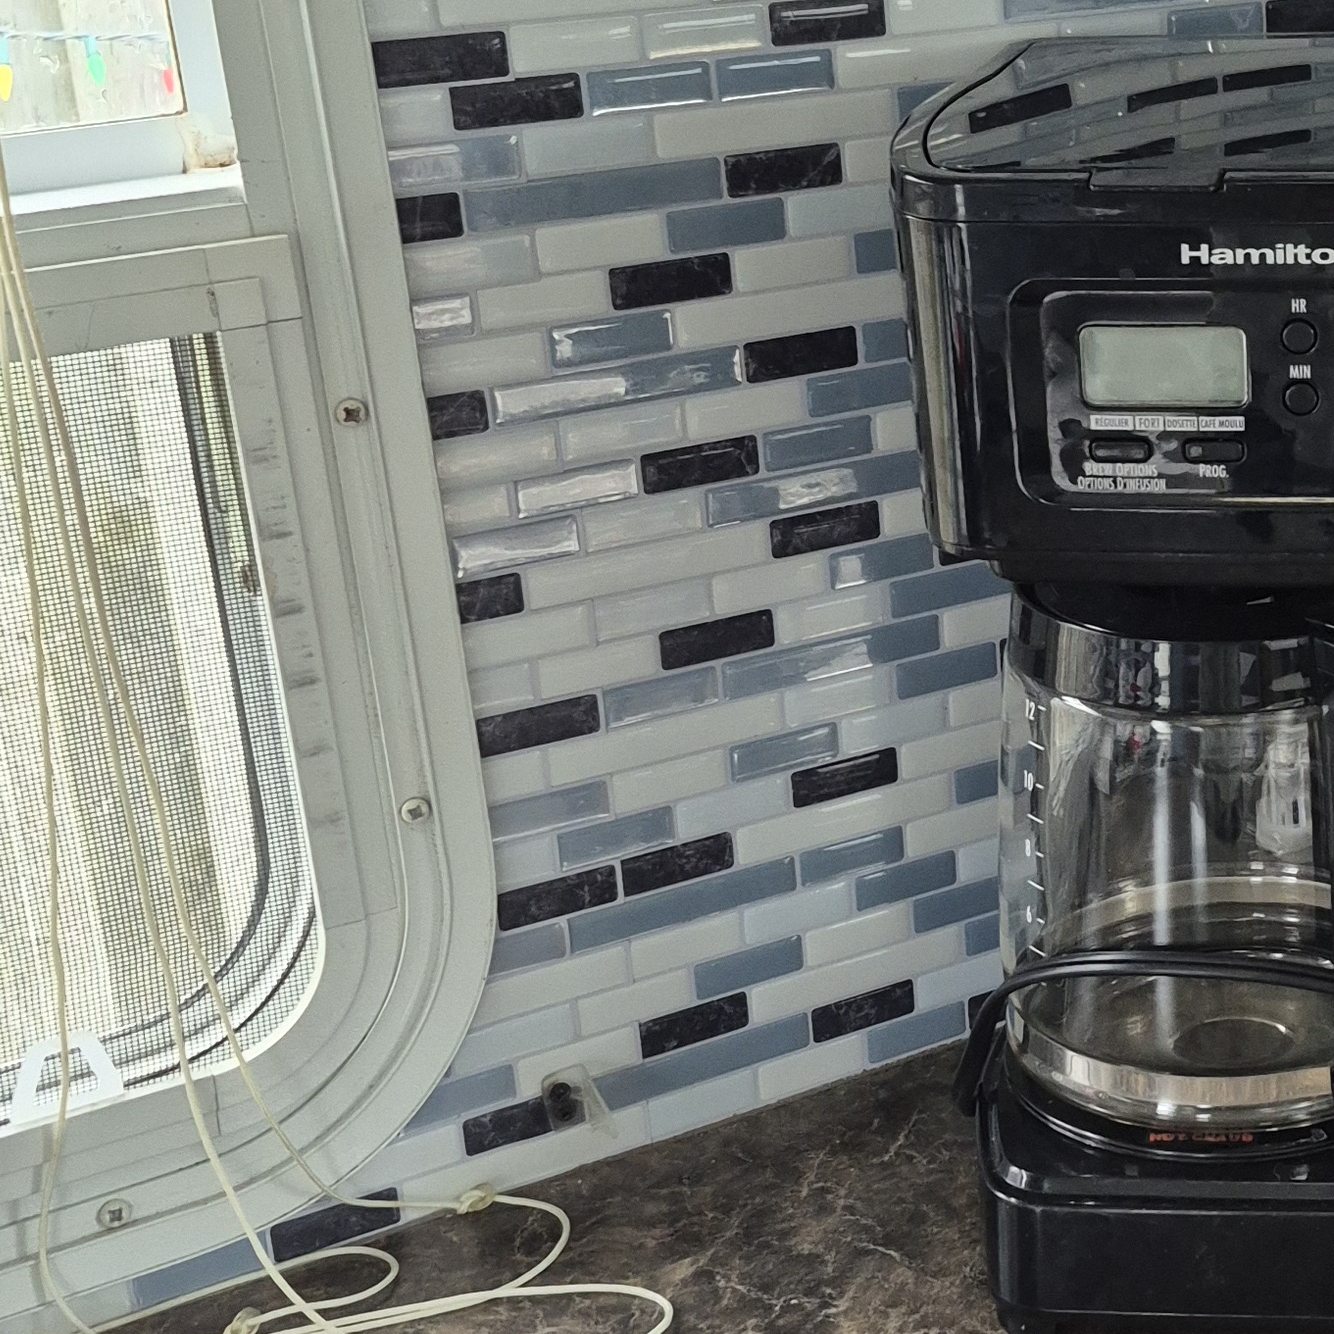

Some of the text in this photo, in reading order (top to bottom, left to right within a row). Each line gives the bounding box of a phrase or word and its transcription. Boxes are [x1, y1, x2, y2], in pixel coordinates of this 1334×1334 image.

[1291, 298, 1308, 314] HR
[1289, 364, 1312, 380] MIN
[1138, 417, 1161, 429] FORT
[1166, 418, 1197, 429] DOSETTE
[1218, 418, 1244, 429] MOULU
[1025, 698, 1036, 720] 12
[1023, 769, 1034, 792] 10
[1024, 838, 1032, 857] 8
[1025, 904, 1033, 923] 6
